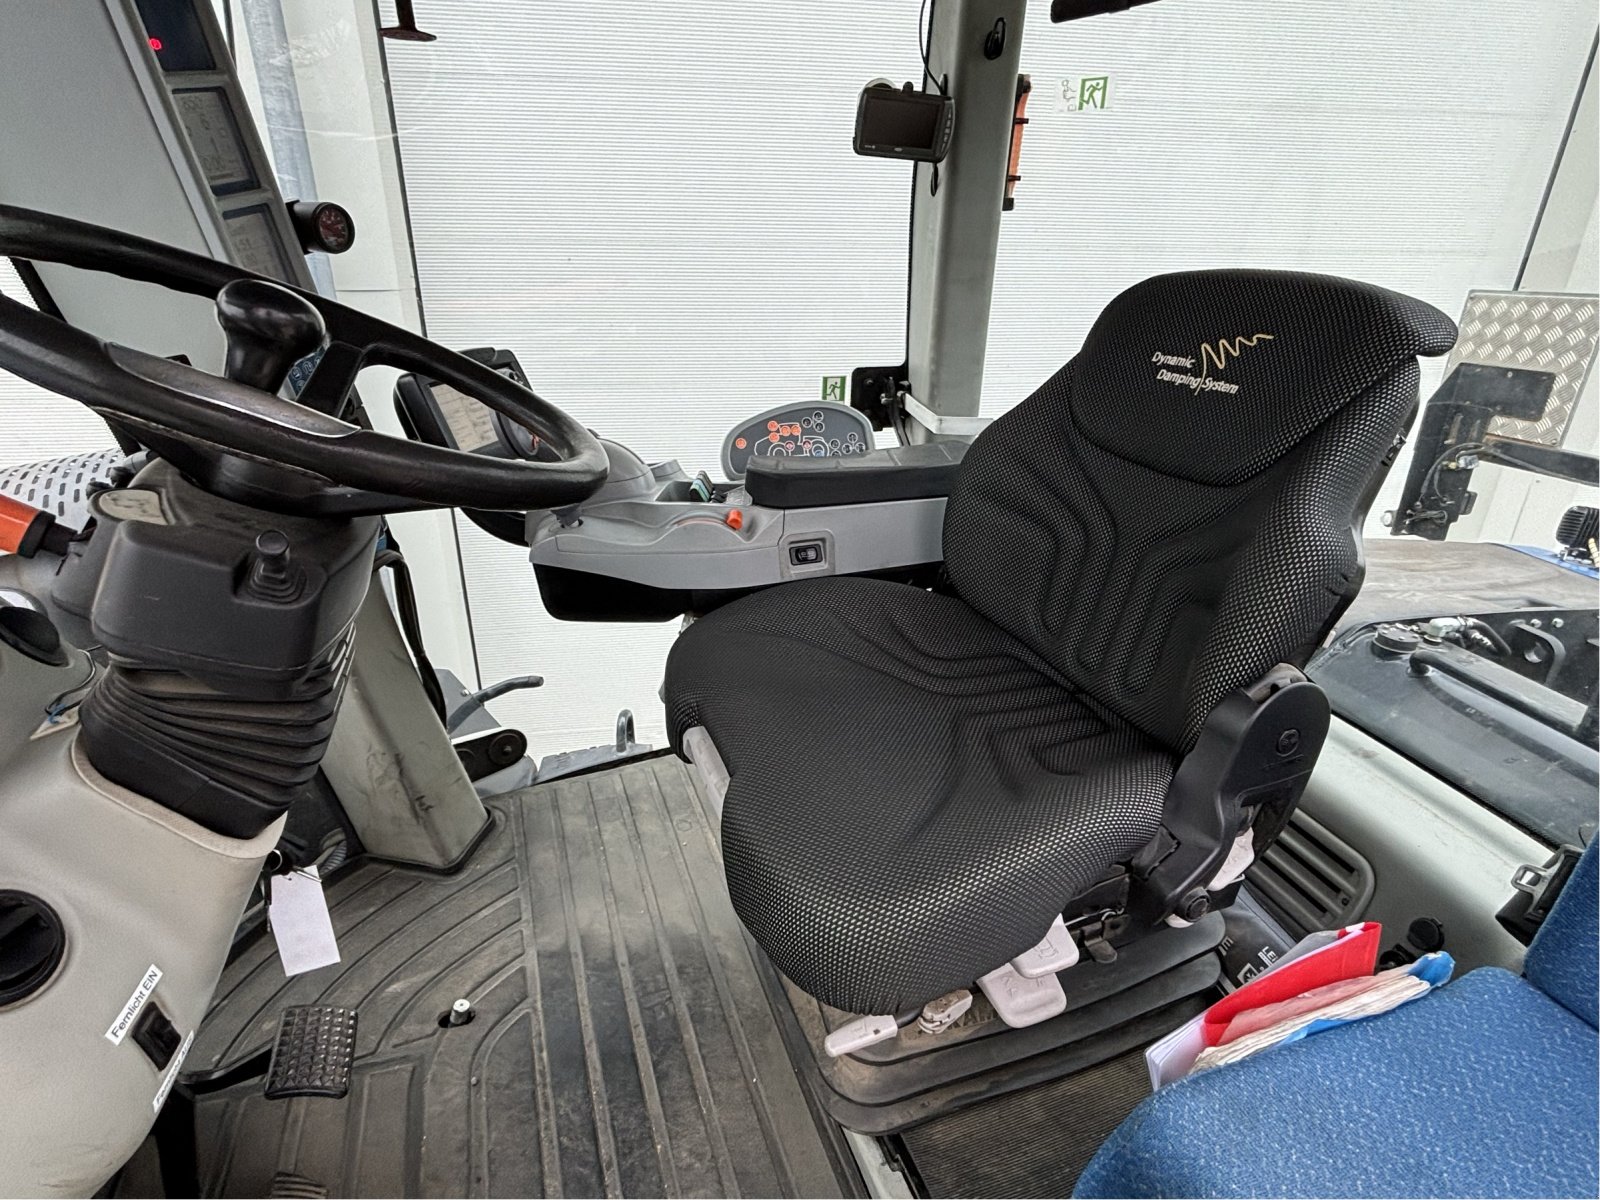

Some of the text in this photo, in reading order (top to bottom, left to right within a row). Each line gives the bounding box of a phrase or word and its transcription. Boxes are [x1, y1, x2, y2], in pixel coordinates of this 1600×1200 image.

[1151, 351, 1196, 368] Dynamic
[1156, 369, 1239, 394] Damping System
[111, 970, 158, 1038] Fernlicht EIN
